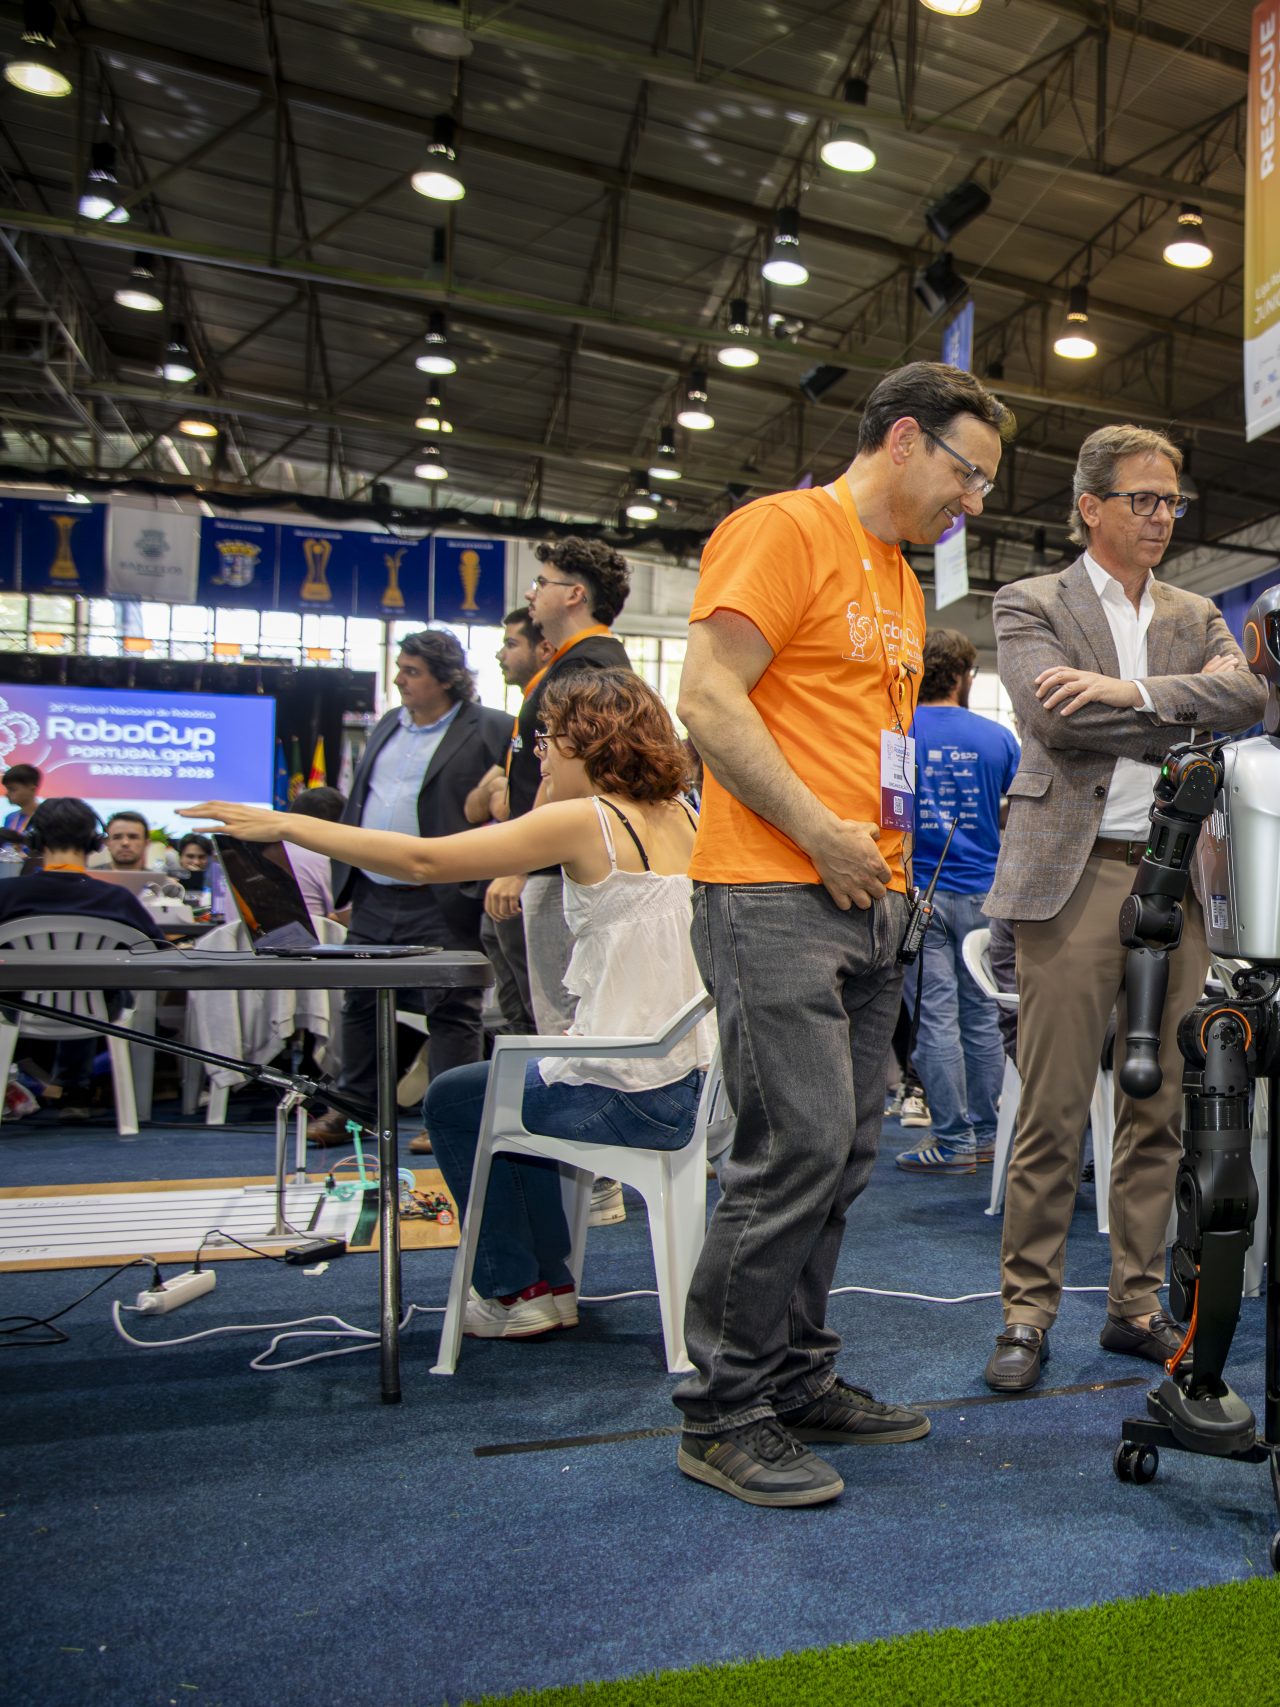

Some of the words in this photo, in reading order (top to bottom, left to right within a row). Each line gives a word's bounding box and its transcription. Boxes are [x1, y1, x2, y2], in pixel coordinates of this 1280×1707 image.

[1260, 12, 1277, 182] RESCUE
[47, 715, 217, 750] RoboCup
[88, 764, 173, 778] BARCELOS
